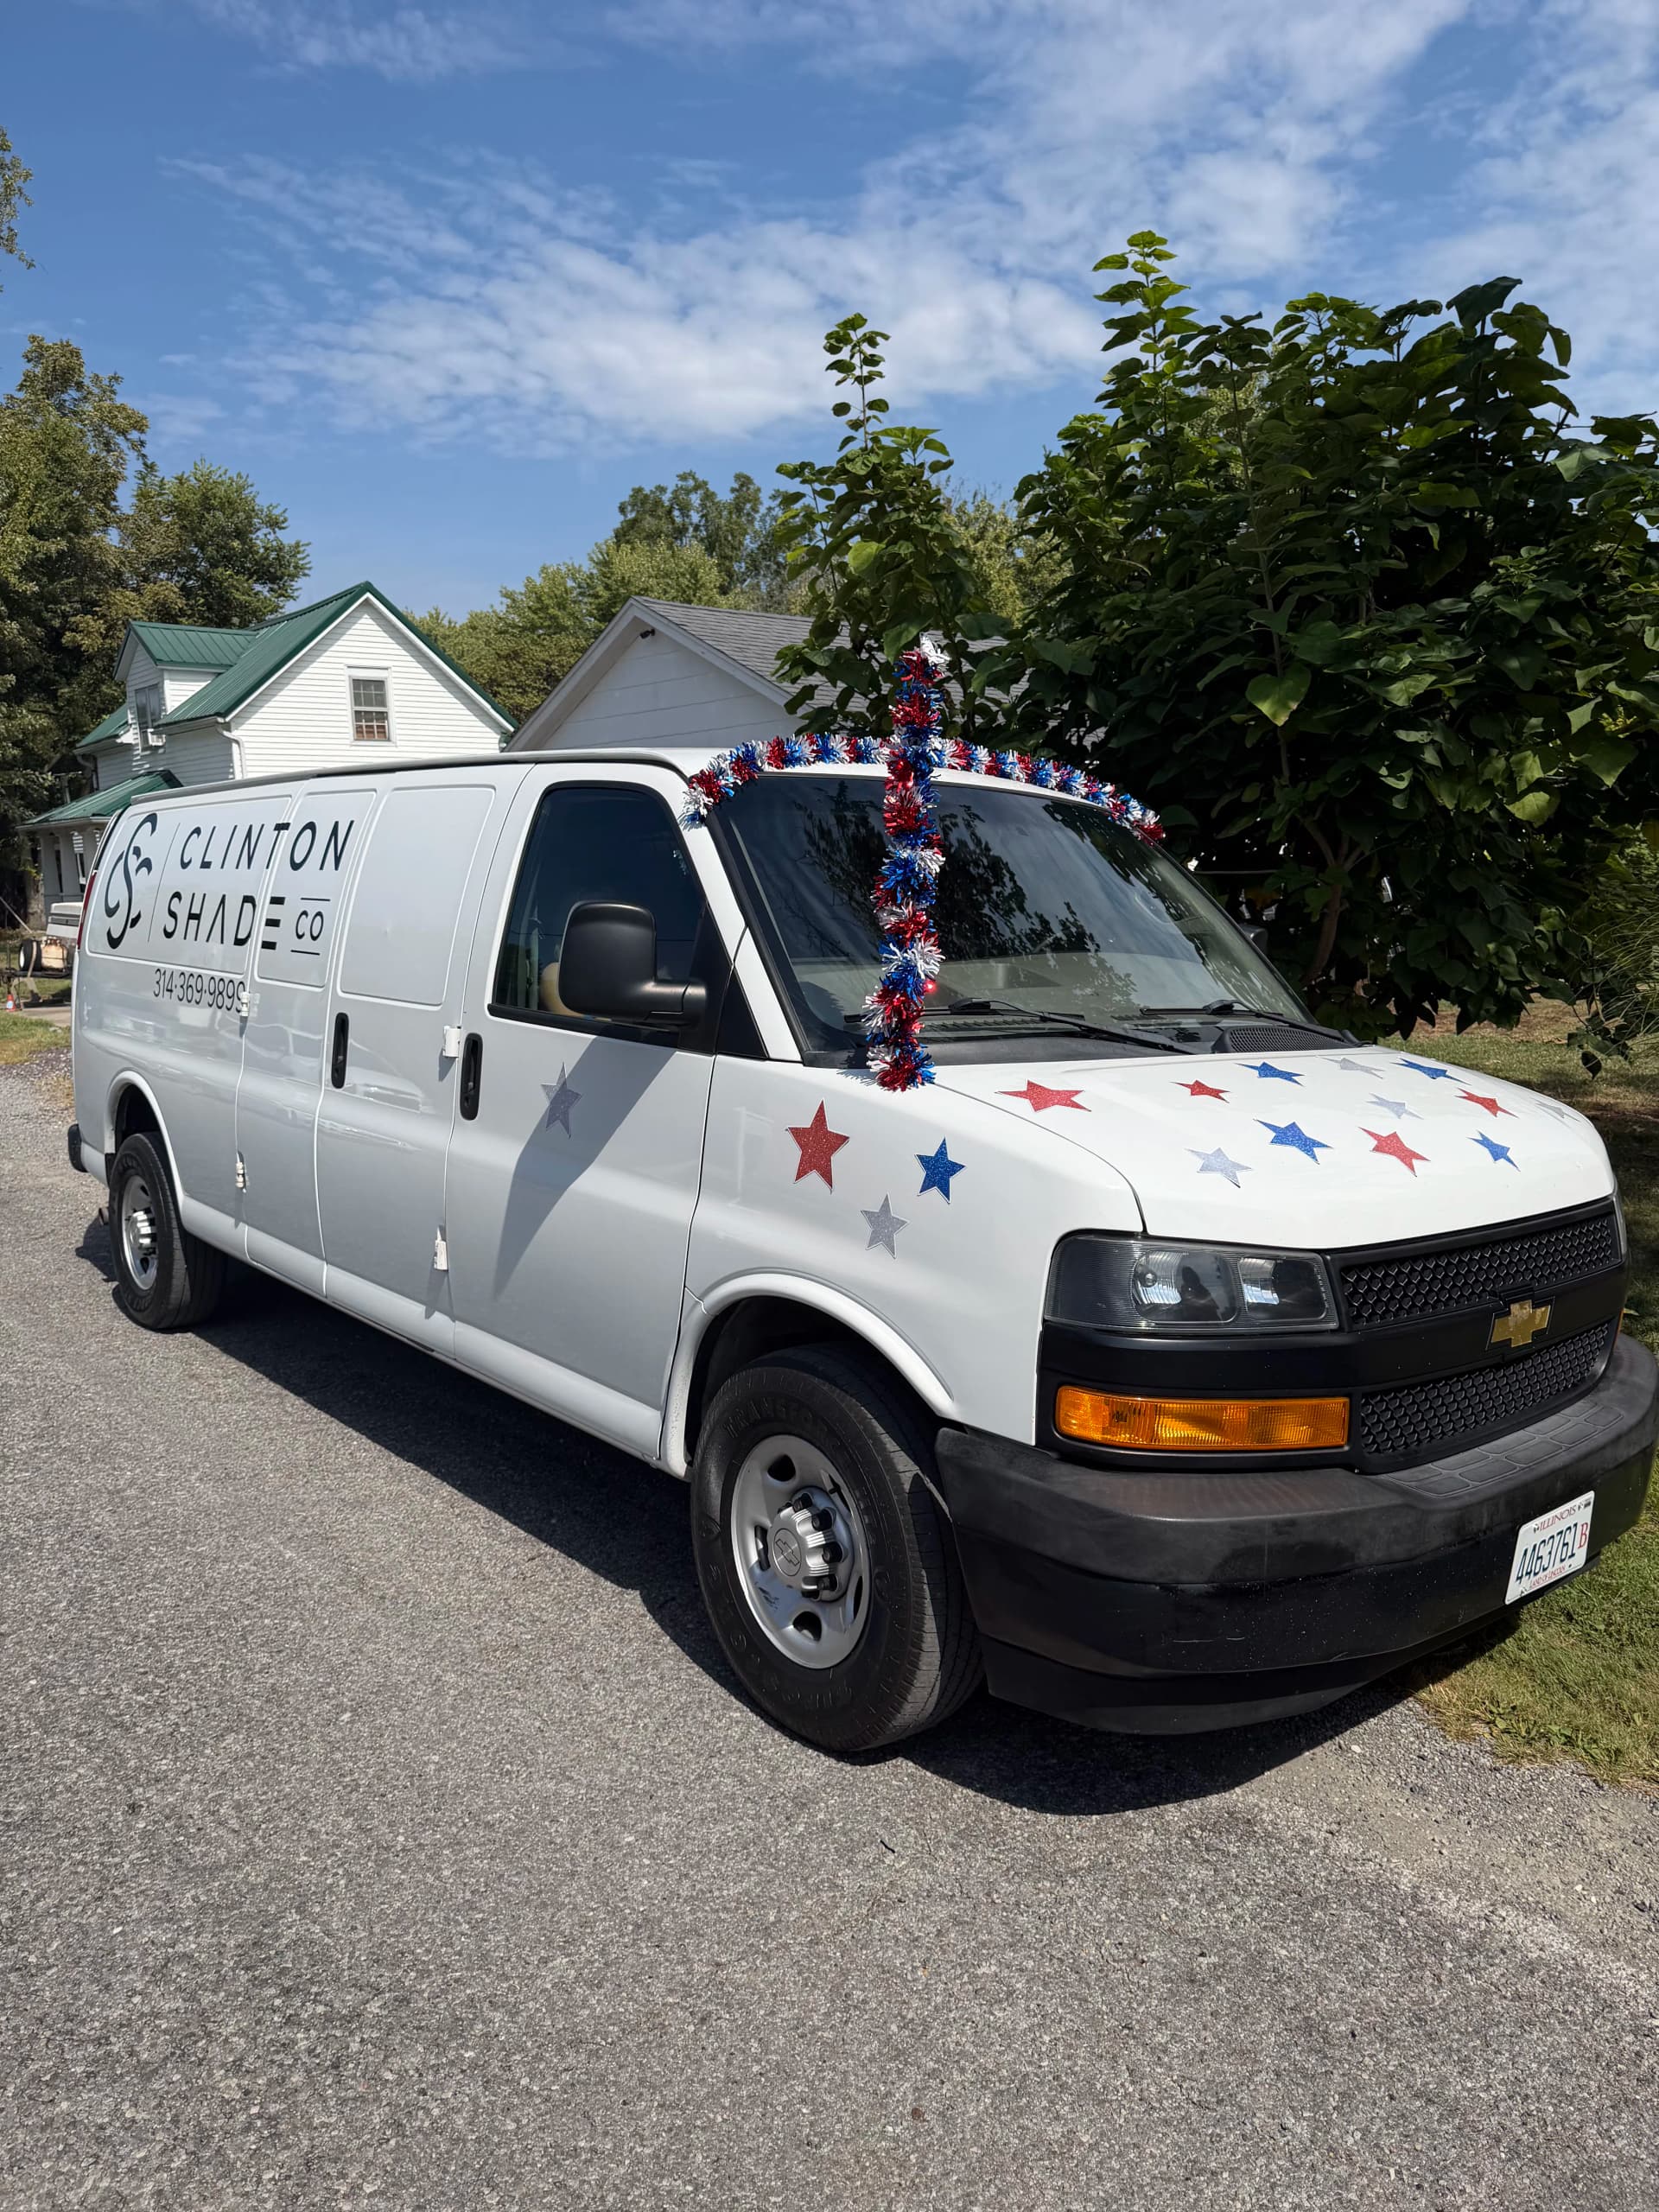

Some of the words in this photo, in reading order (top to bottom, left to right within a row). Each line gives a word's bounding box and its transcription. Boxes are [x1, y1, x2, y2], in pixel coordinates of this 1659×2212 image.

[179, 820, 354, 871] CLINTON
[162, 891, 286, 950] SHADE
[295, 910, 325, 941] CO
[1538, 1504, 1577, 1531] ILLINOIS
[1516, 1522, 1578, 1585] 4463761
[1577, 1522, 1589, 1549] B
